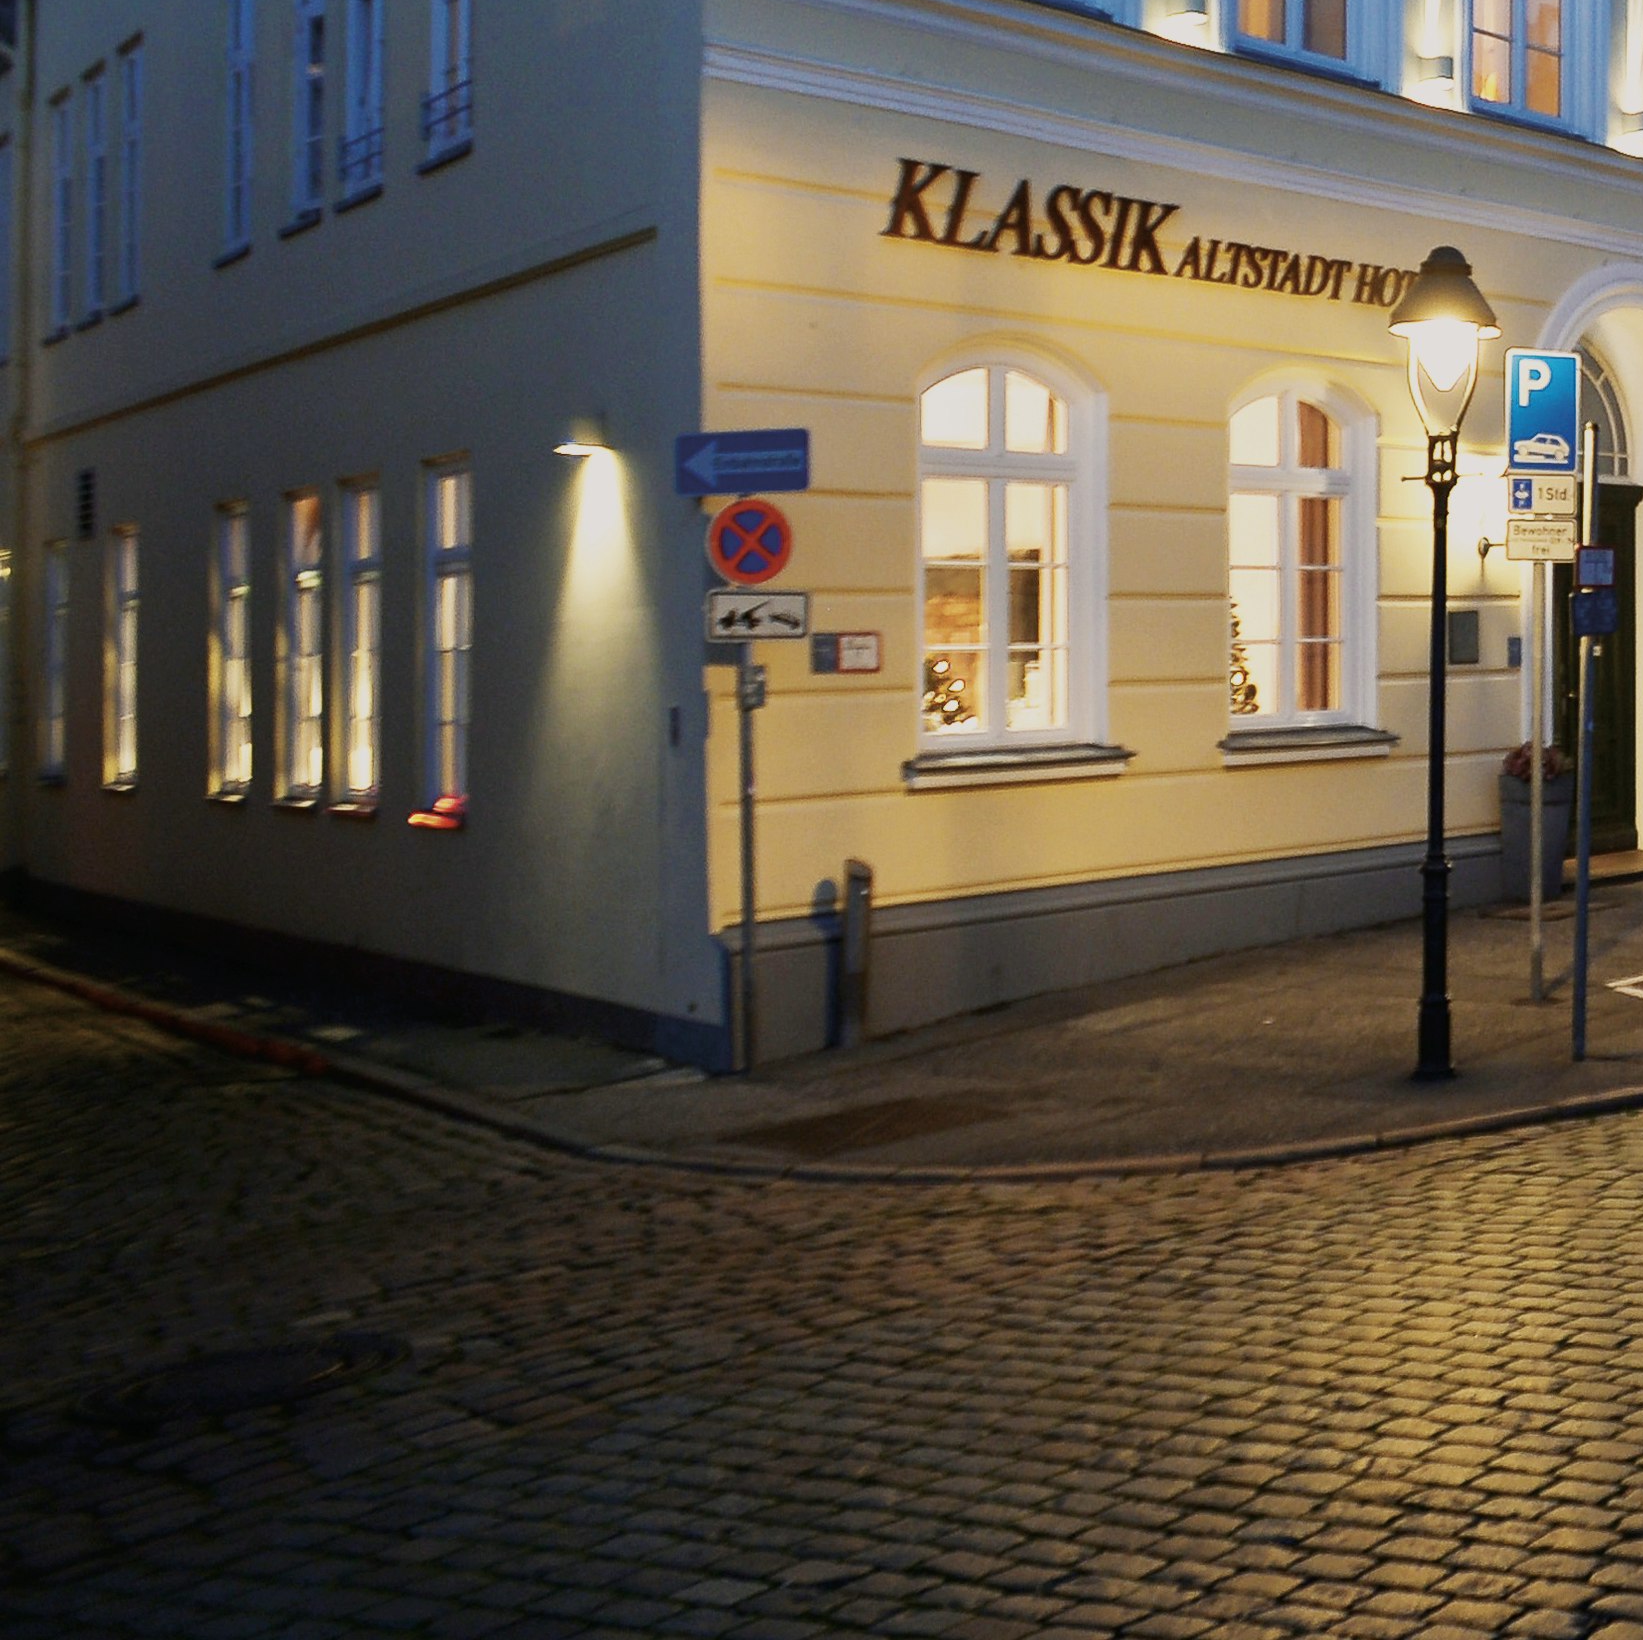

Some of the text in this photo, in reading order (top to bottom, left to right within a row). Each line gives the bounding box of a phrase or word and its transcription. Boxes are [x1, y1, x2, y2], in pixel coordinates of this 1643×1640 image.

[879, 158, 1180, 276] KLASSIK
[1174, 236, 1353, 300] ALTSTADT
[1519, 358, 1552, 407] P
[1538, 487, 1543, 499] 1
[1513, 524, 1568, 536] Bewohner
[1532, 545, 1550, 555] frei
